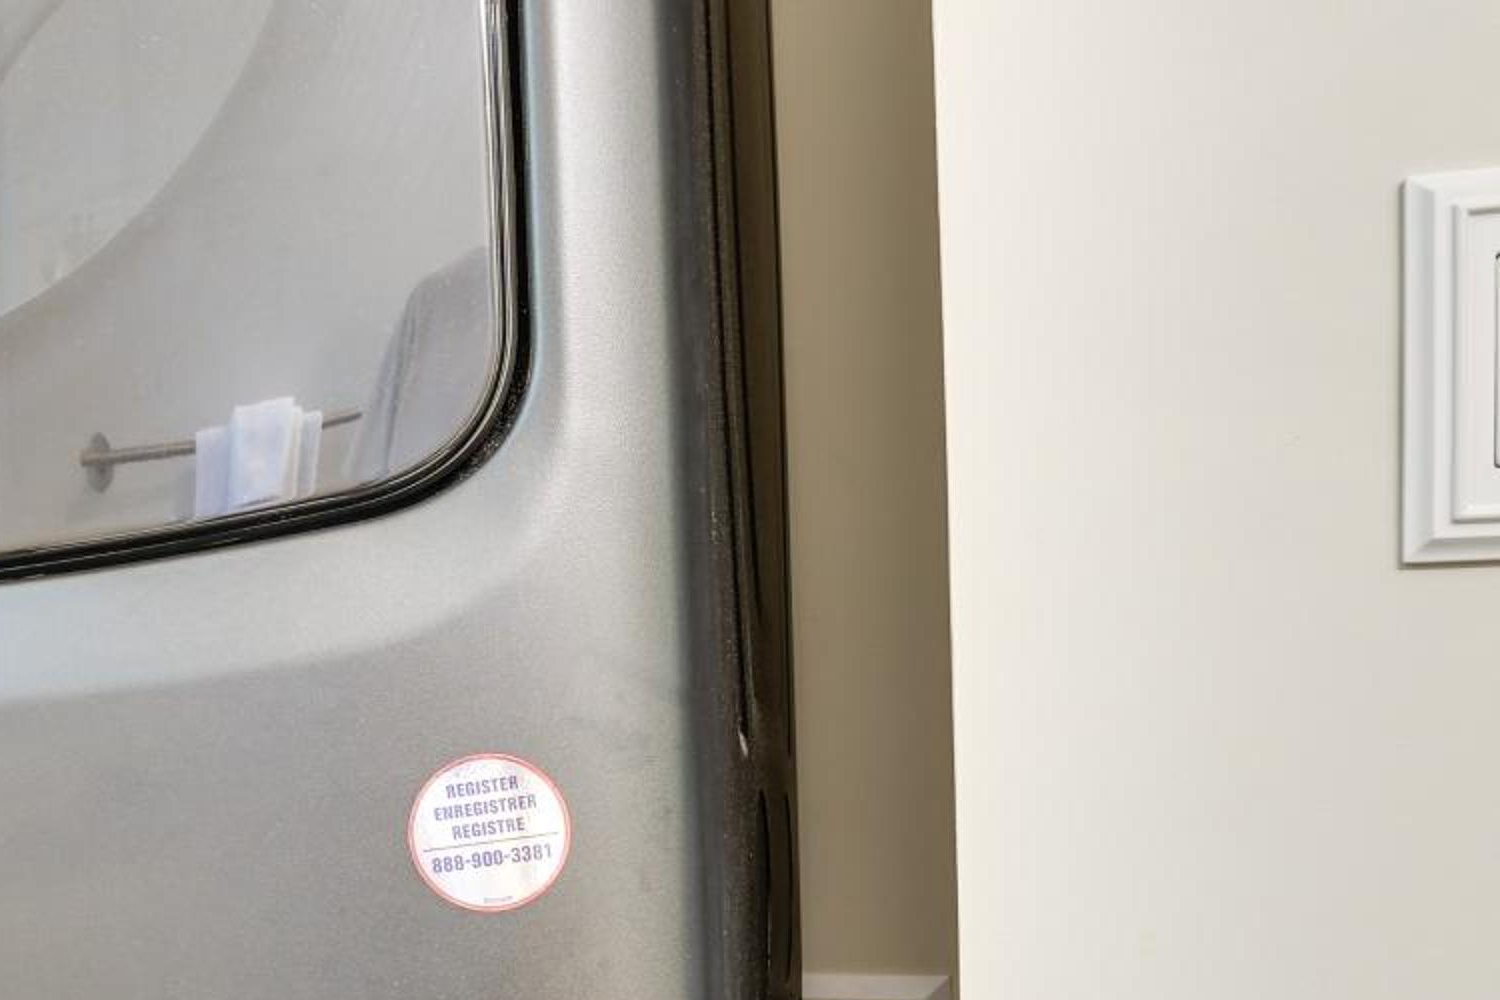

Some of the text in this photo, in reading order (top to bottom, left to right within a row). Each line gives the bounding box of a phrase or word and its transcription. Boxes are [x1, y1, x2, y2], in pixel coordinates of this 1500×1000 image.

[446, 776, 519, 799] REGISTER
[434, 794, 537, 822] ENREGISTRER
[452, 818, 526, 840] REGISTRE
[432, 844, 553, 873] 888-900-3381
